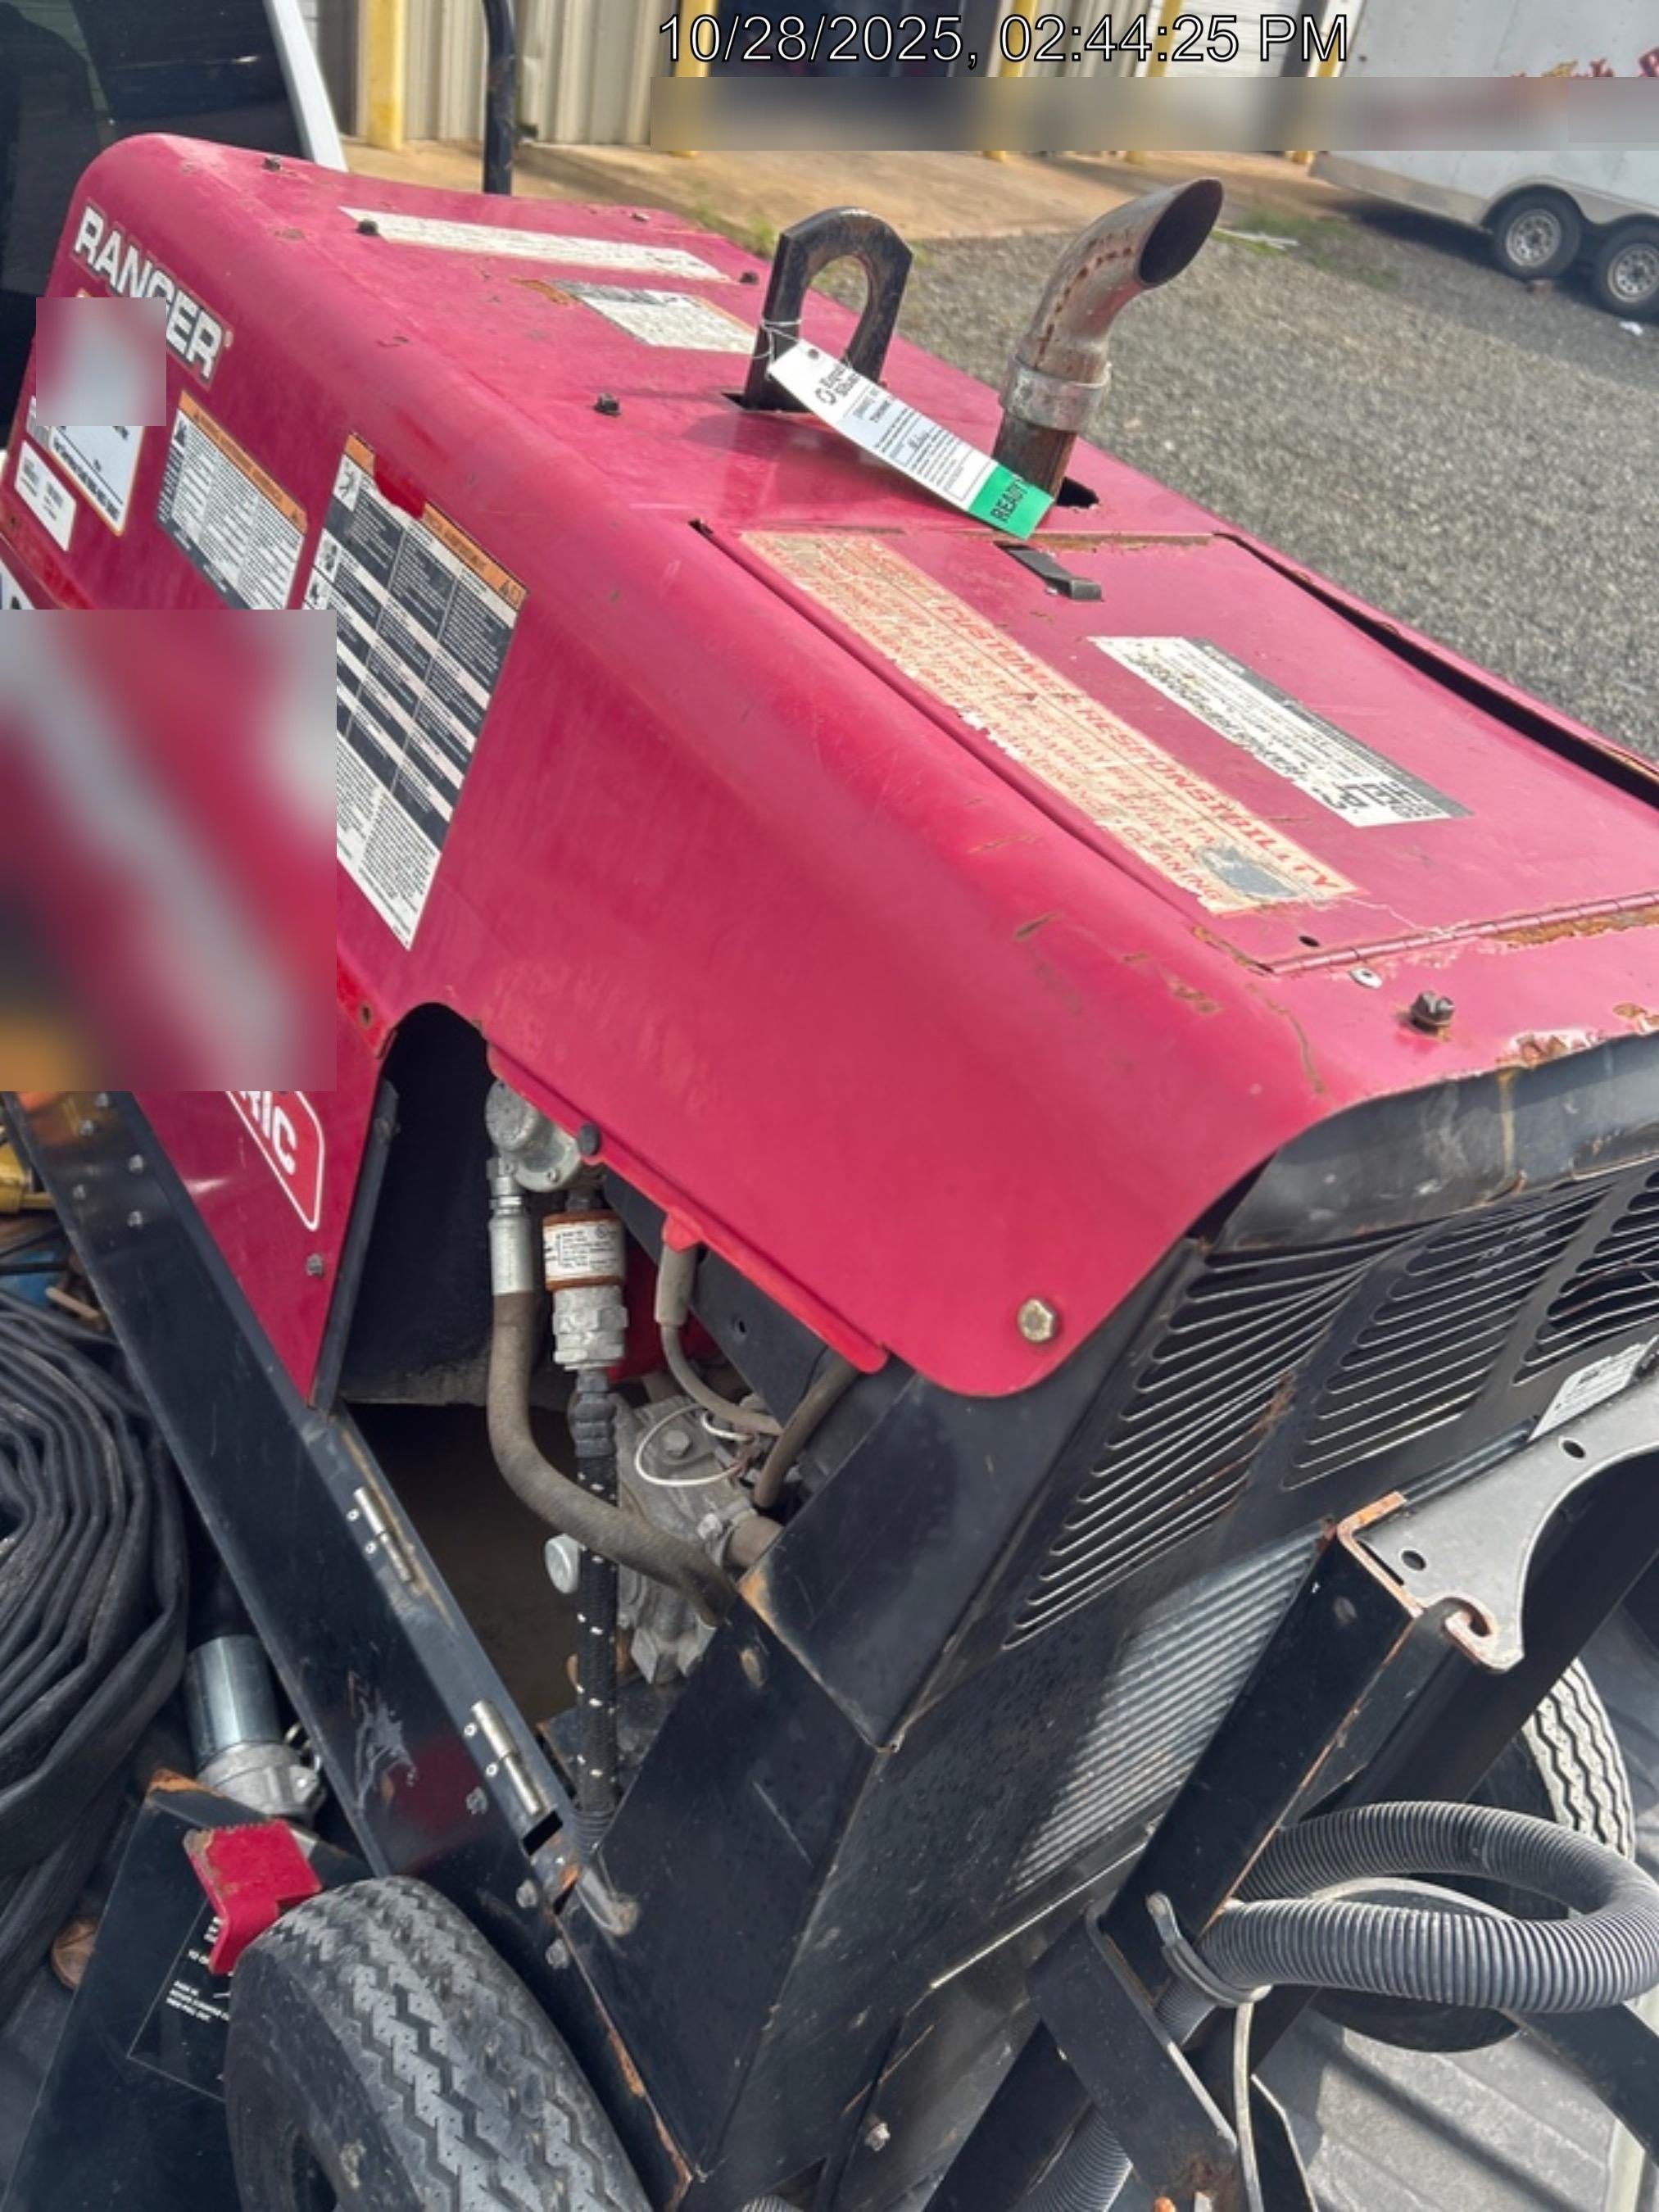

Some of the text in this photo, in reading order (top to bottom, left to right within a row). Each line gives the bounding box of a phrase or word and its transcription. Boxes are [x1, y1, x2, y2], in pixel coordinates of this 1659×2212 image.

[74, 206, 224, 379] RANGER
[990, 478, 1027, 523] READY
[933, 605, 1084, 704] CUSTOMER
[1117, 826, 1224, 900] CLEANING
